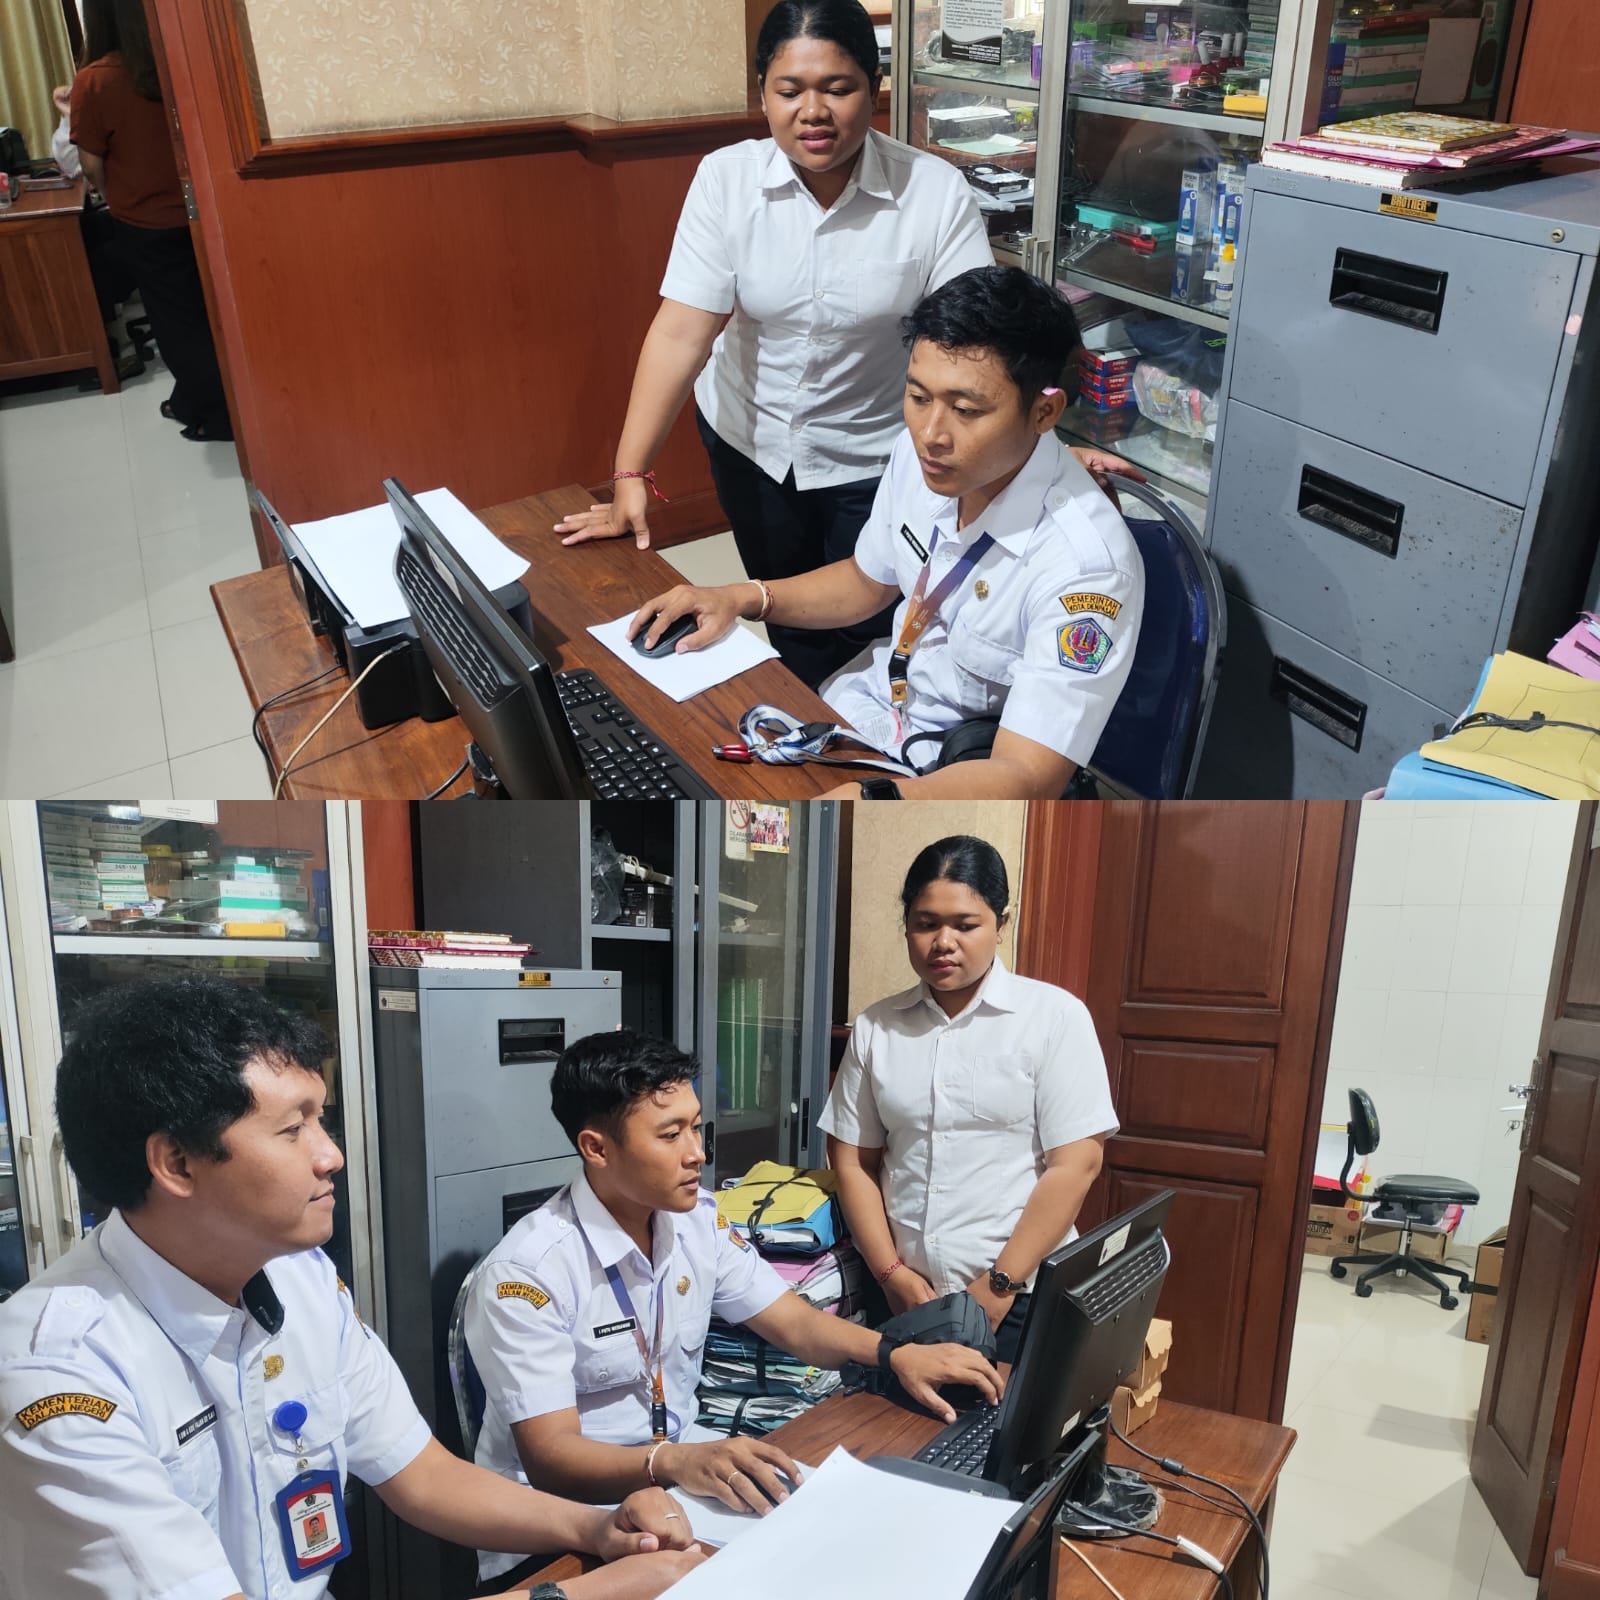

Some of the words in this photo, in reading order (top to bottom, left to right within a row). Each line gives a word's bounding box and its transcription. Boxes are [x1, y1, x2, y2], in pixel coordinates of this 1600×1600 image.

[1065, 594, 1119, 609] PEMERINTAH
[1069, 602, 1085, 612] KOTA
[20, 1395, 113, 1420] KEMENTERIAN
[27, 1405, 65, 1427] DALAM
[70, 1404, 106, 1418] NEGERI
